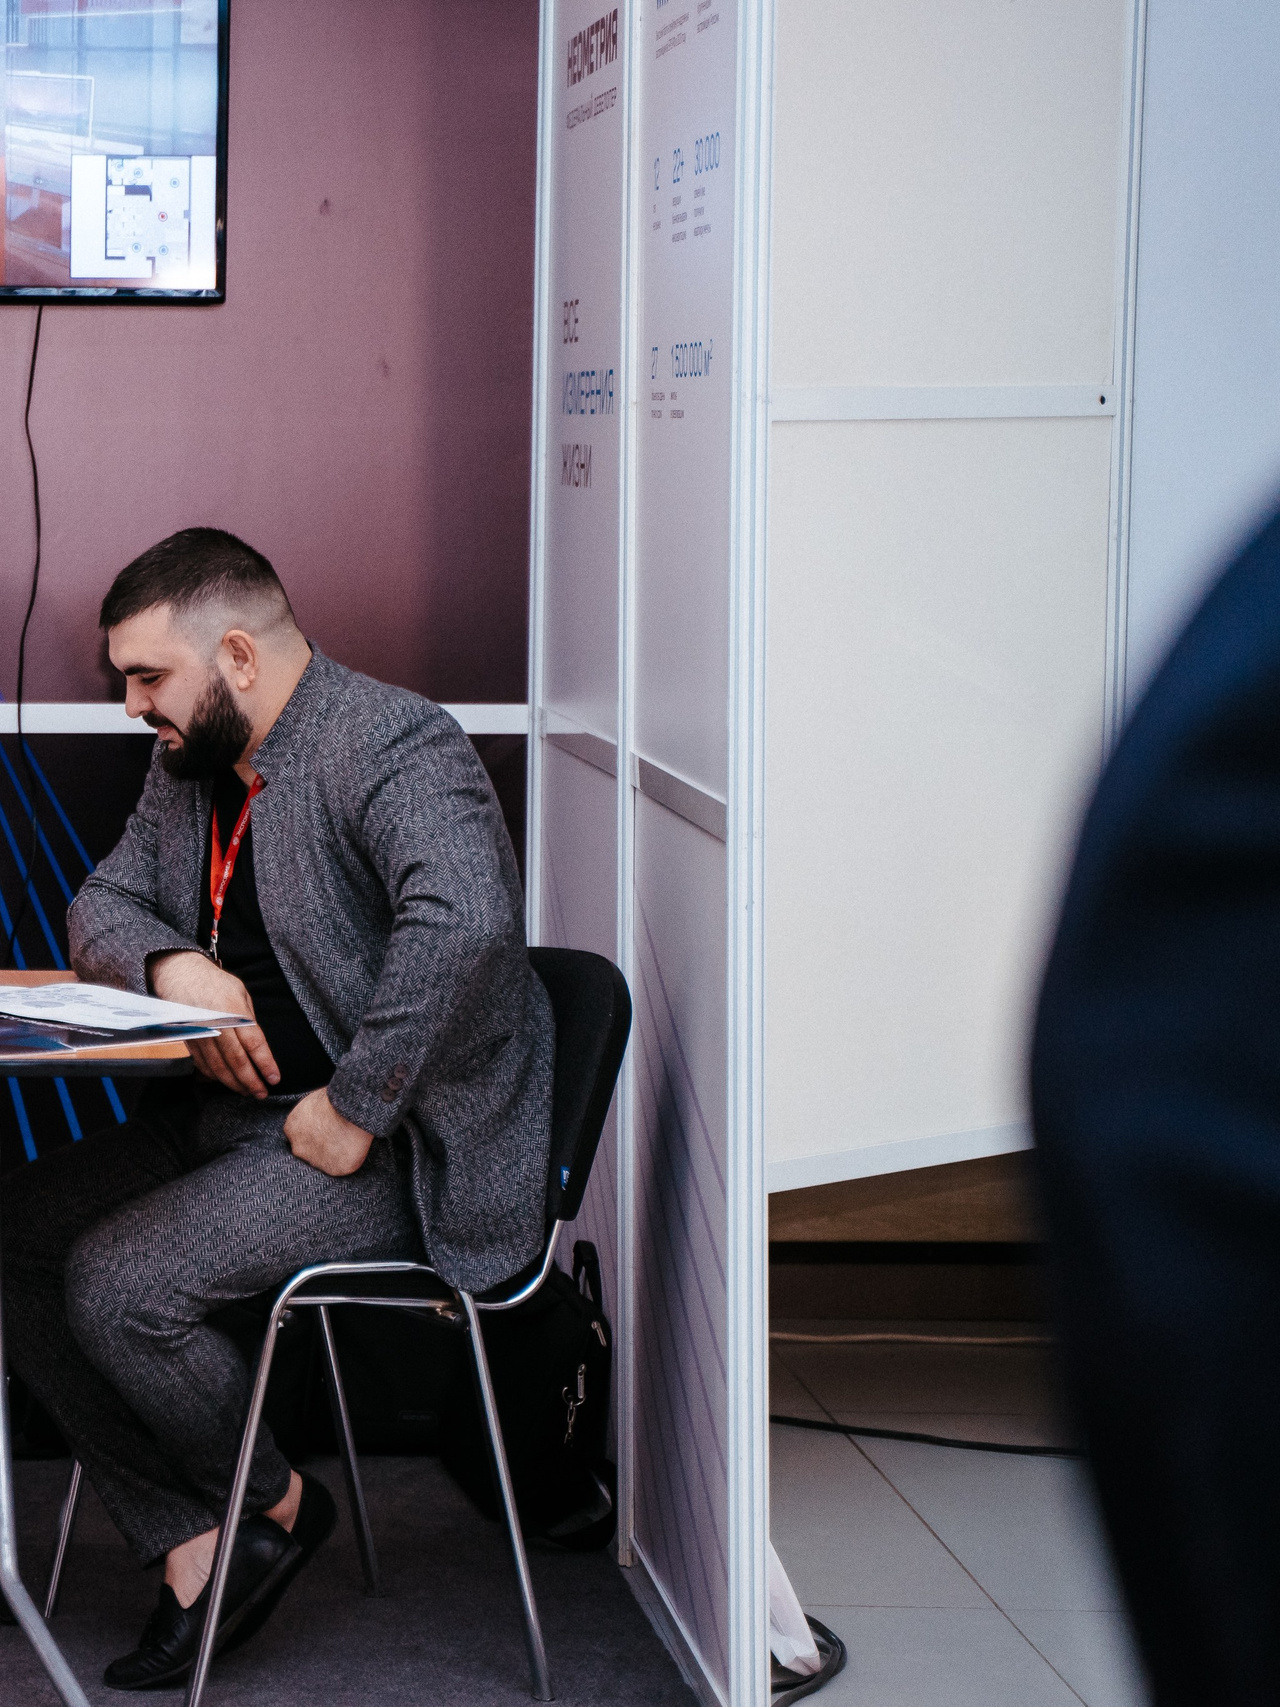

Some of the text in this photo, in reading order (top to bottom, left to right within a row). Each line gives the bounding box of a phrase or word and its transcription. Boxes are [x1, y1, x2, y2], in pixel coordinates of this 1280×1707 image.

[567, 8, 618, 88] НЕОМЕТРИЯ
[672, 148, 684, 184] 22+
[563, 299, 579, 344] ВСЕ
[651, 346, 659, 380] 27
[562, 369, 614, 415] ИЗМЕРЕНИЯ
[561, 443, 592, 488] ЖИЗНИ
